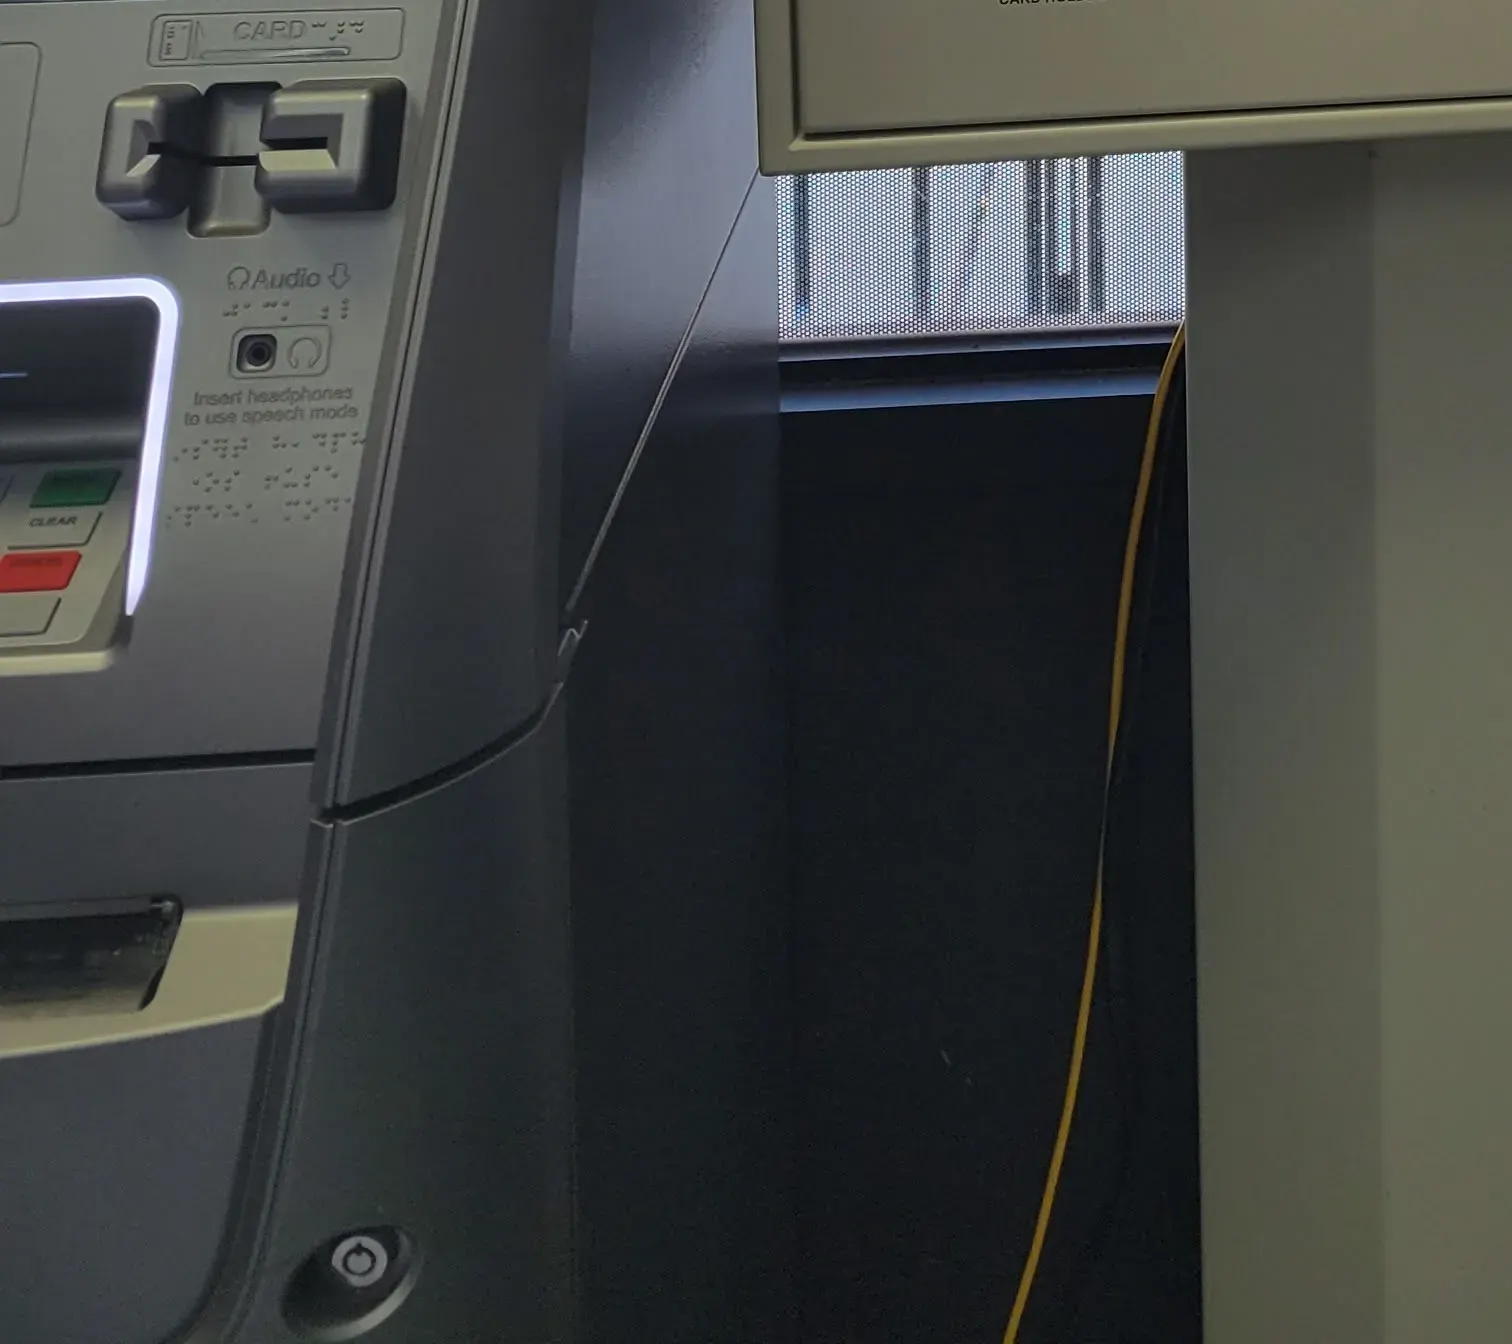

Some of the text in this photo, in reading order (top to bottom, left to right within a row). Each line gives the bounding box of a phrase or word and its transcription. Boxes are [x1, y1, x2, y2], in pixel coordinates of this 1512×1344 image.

[233, 18, 306, 40] CARD
[251, 267, 321, 290] Audio
[193, 386, 353, 406] Insert headphones
[184, 404, 359, 426] to use speech mode
[28, 515, 78, 528] CLEAR
